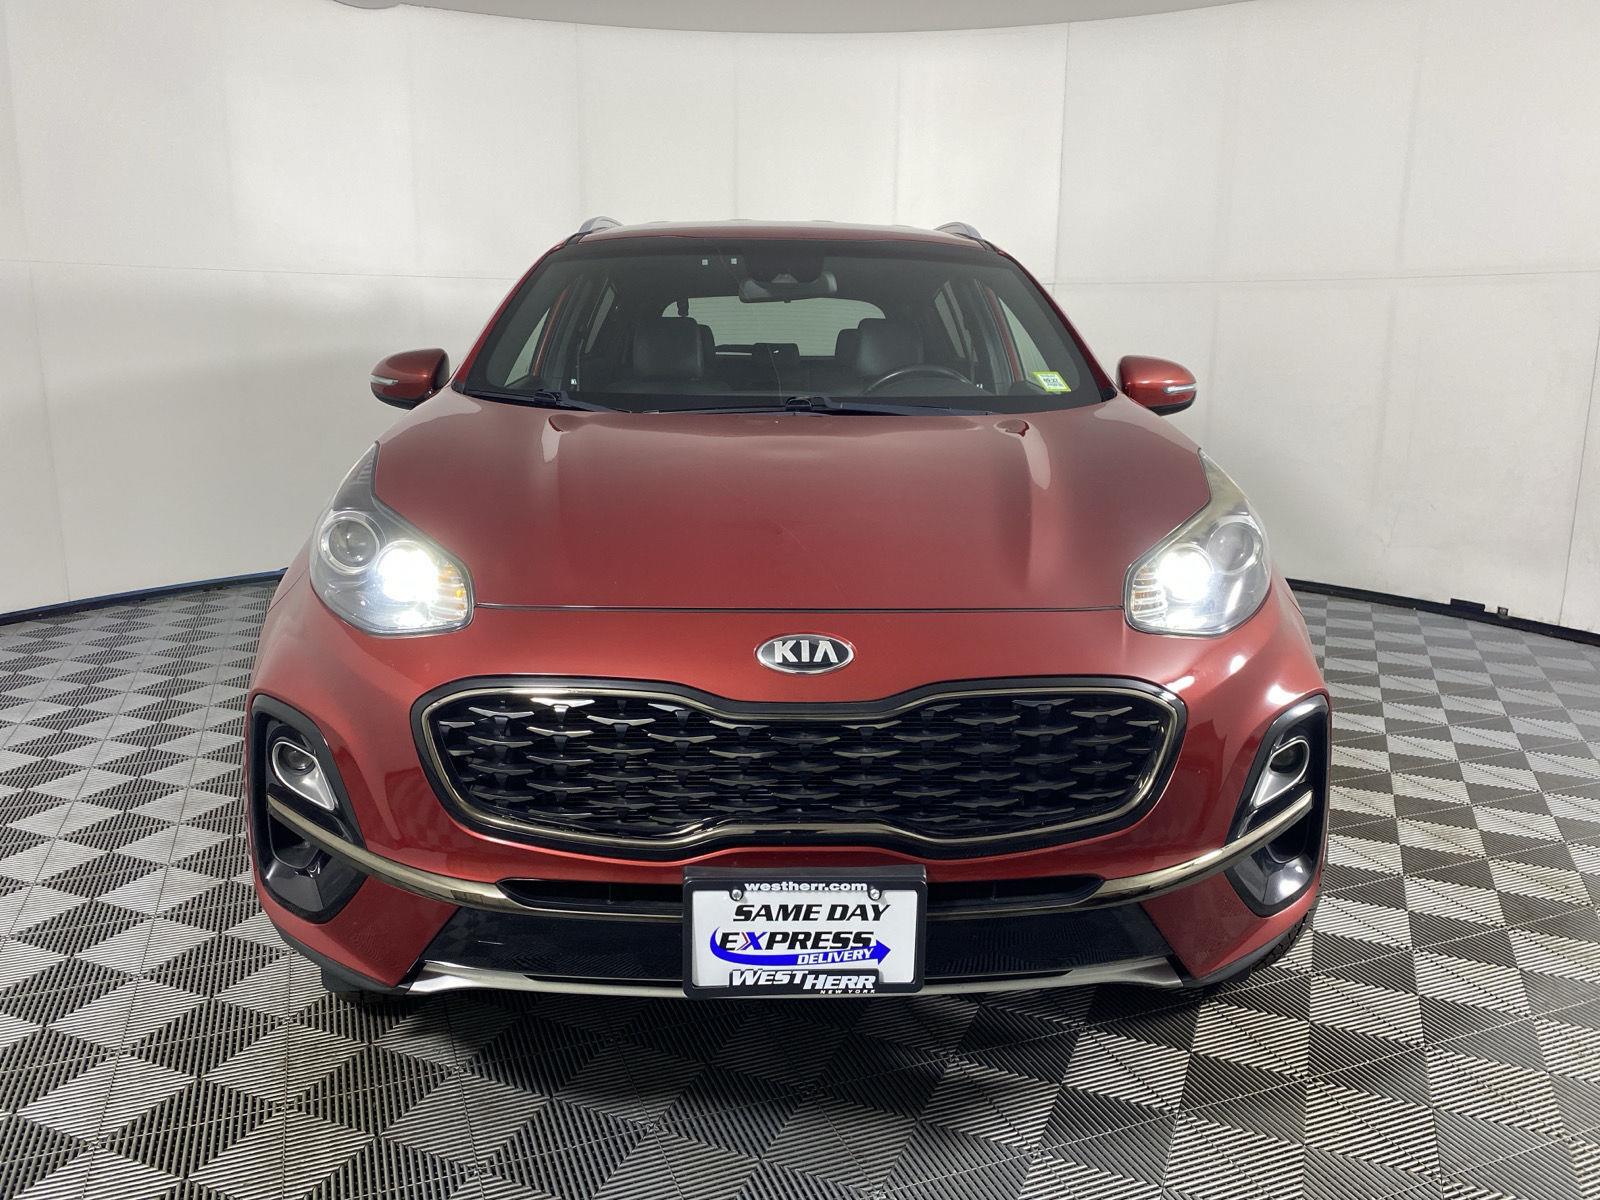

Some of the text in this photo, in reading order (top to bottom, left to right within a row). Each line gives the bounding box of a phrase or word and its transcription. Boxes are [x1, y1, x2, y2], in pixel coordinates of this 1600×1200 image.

[773, 640, 839, 662] KIA
[745, 882, 867, 891] westherr.com
[733, 904, 891, 922] SAME DAY
[718, 931, 874, 951] EXPRESS
[797, 948, 874, 965] DELIVERY
